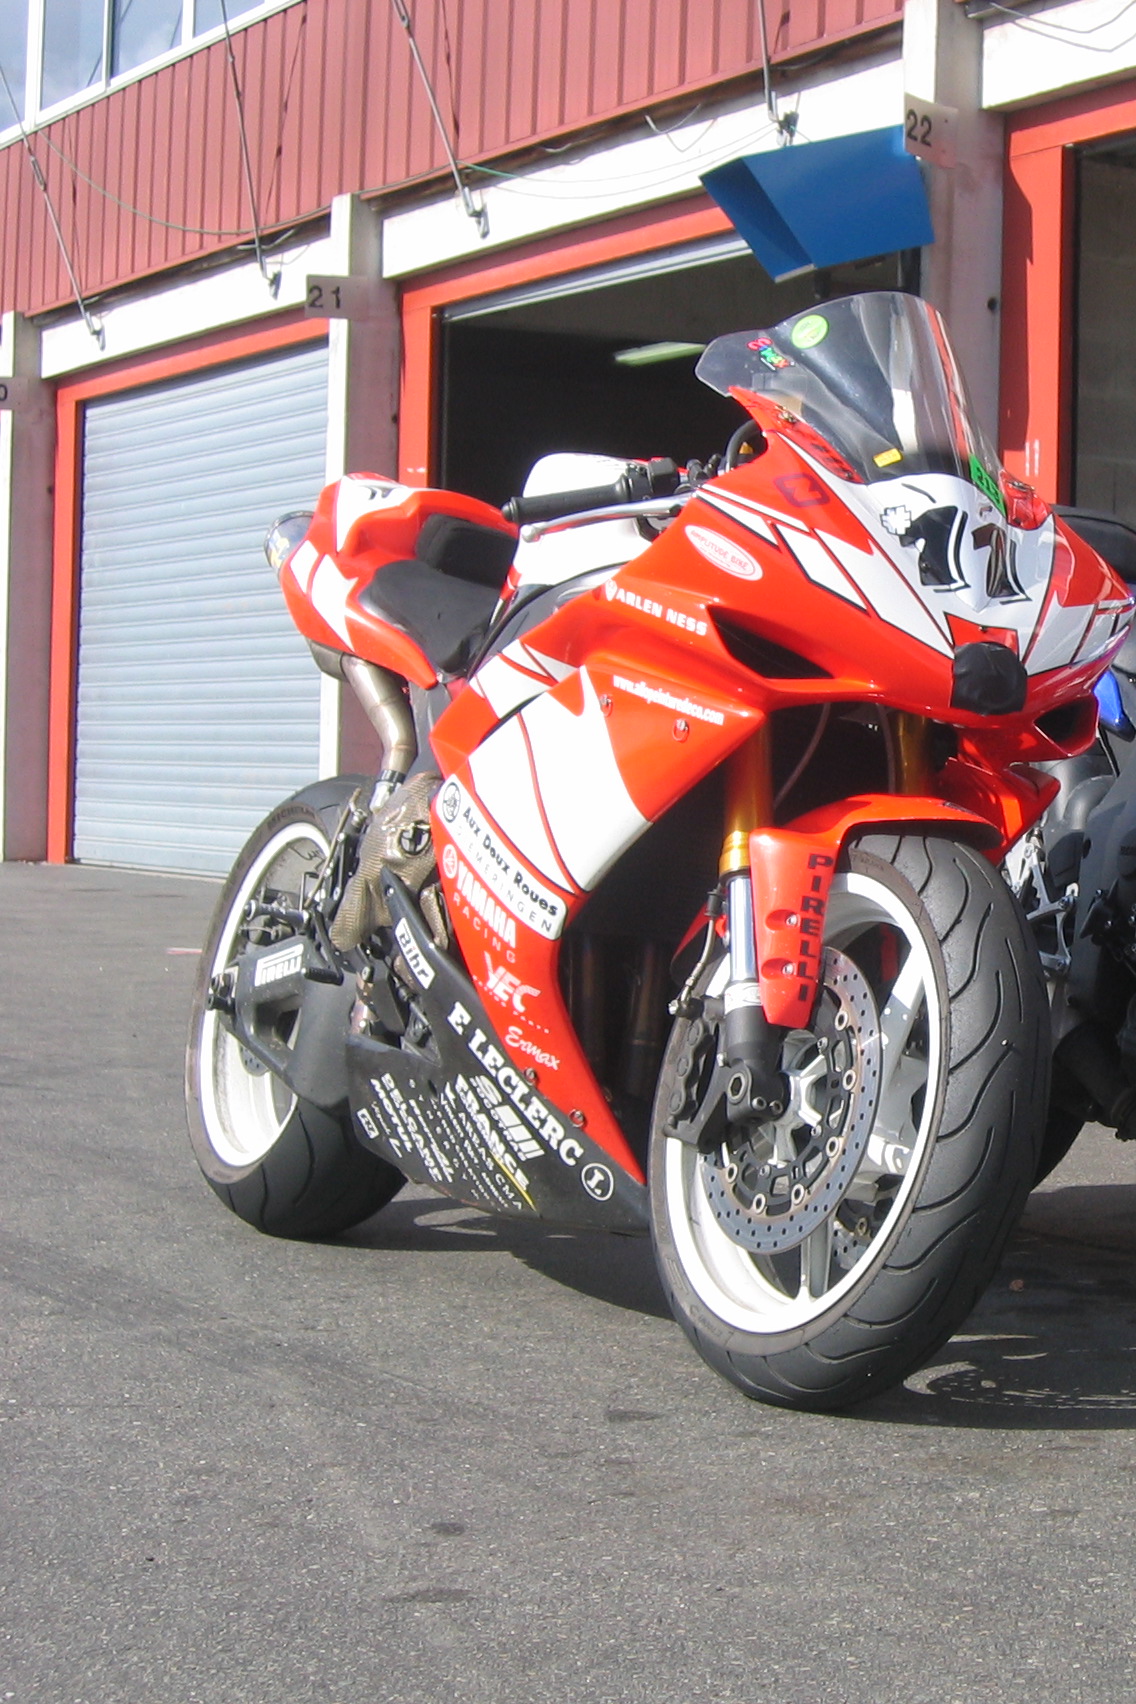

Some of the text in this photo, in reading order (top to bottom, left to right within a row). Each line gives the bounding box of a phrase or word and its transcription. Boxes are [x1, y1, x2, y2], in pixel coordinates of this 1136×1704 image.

[907, 109, 932, 148] 22
[309, 285, 341, 309] 21
[615, 588, 708, 636] ARLEN NESS
[463, 806, 481, 837] Aux
[513, 870, 558, 917] Roues
[453, 892, 515, 964] RACING
[456, 859, 516, 948] YAMAHA
[797, 853, 834, 1002] PIRELLI
[254, 943, 304, 987] PIRELLI
[398, 932, 430, 980] Bihr
[484, 950, 541, 1013] YEC
[370, 1078, 412, 1153] MOTUL
[447, 1001, 471, 1035] E
[468, 1028, 584, 1166] LECLERC
